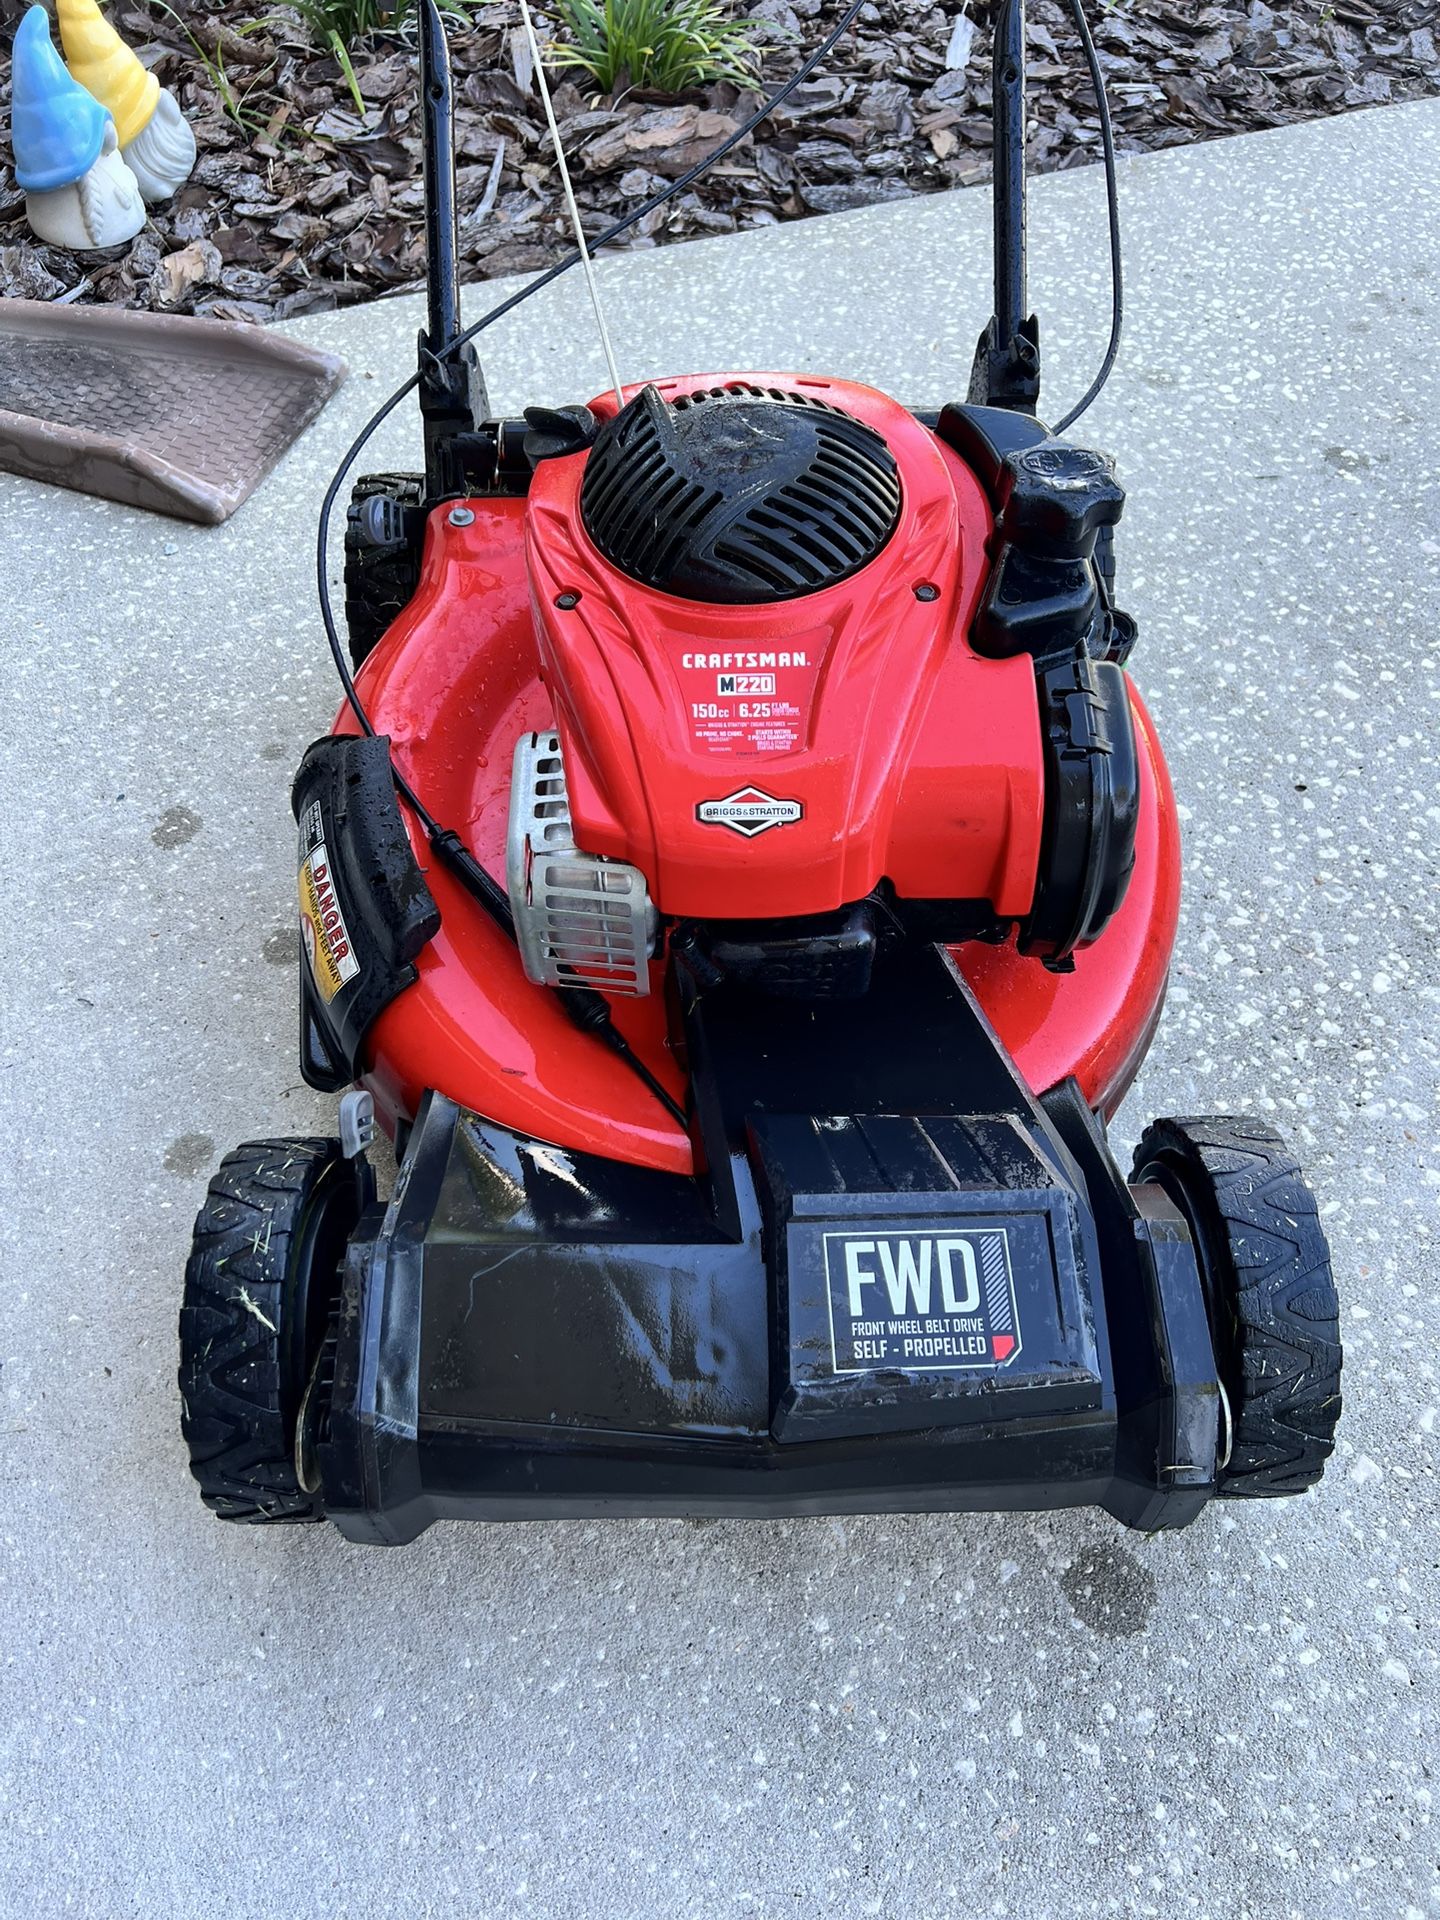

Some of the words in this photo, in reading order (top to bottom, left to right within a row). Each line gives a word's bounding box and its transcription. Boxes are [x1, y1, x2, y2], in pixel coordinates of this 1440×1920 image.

[719, 675, 773, 693] M220
[691, 703, 730, 718] 150cc
[738, 702, 771, 718] 6.25
[304, 865, 313, 886] KEEP
[308, 886, 320, 918] HANDS
[313, 863, 349, 964] DANGER
[314, 918, 324, 935] and
[319, 933, 331, 957] FEET
[326, 957, 342, 985] AWAY
[844, 1238, 981, 1317] FWD
[851, 1321, 886, 1337] FRONT
[887, 1319, 924, 1335] WHEEL
[925, 1318, 951, 1334] BELT
[953, 1317, 985, 1333] DRIVE
[853, 1339, 888, 1360] SELF
[904, 1336, 987, 1358] PROPELLED
